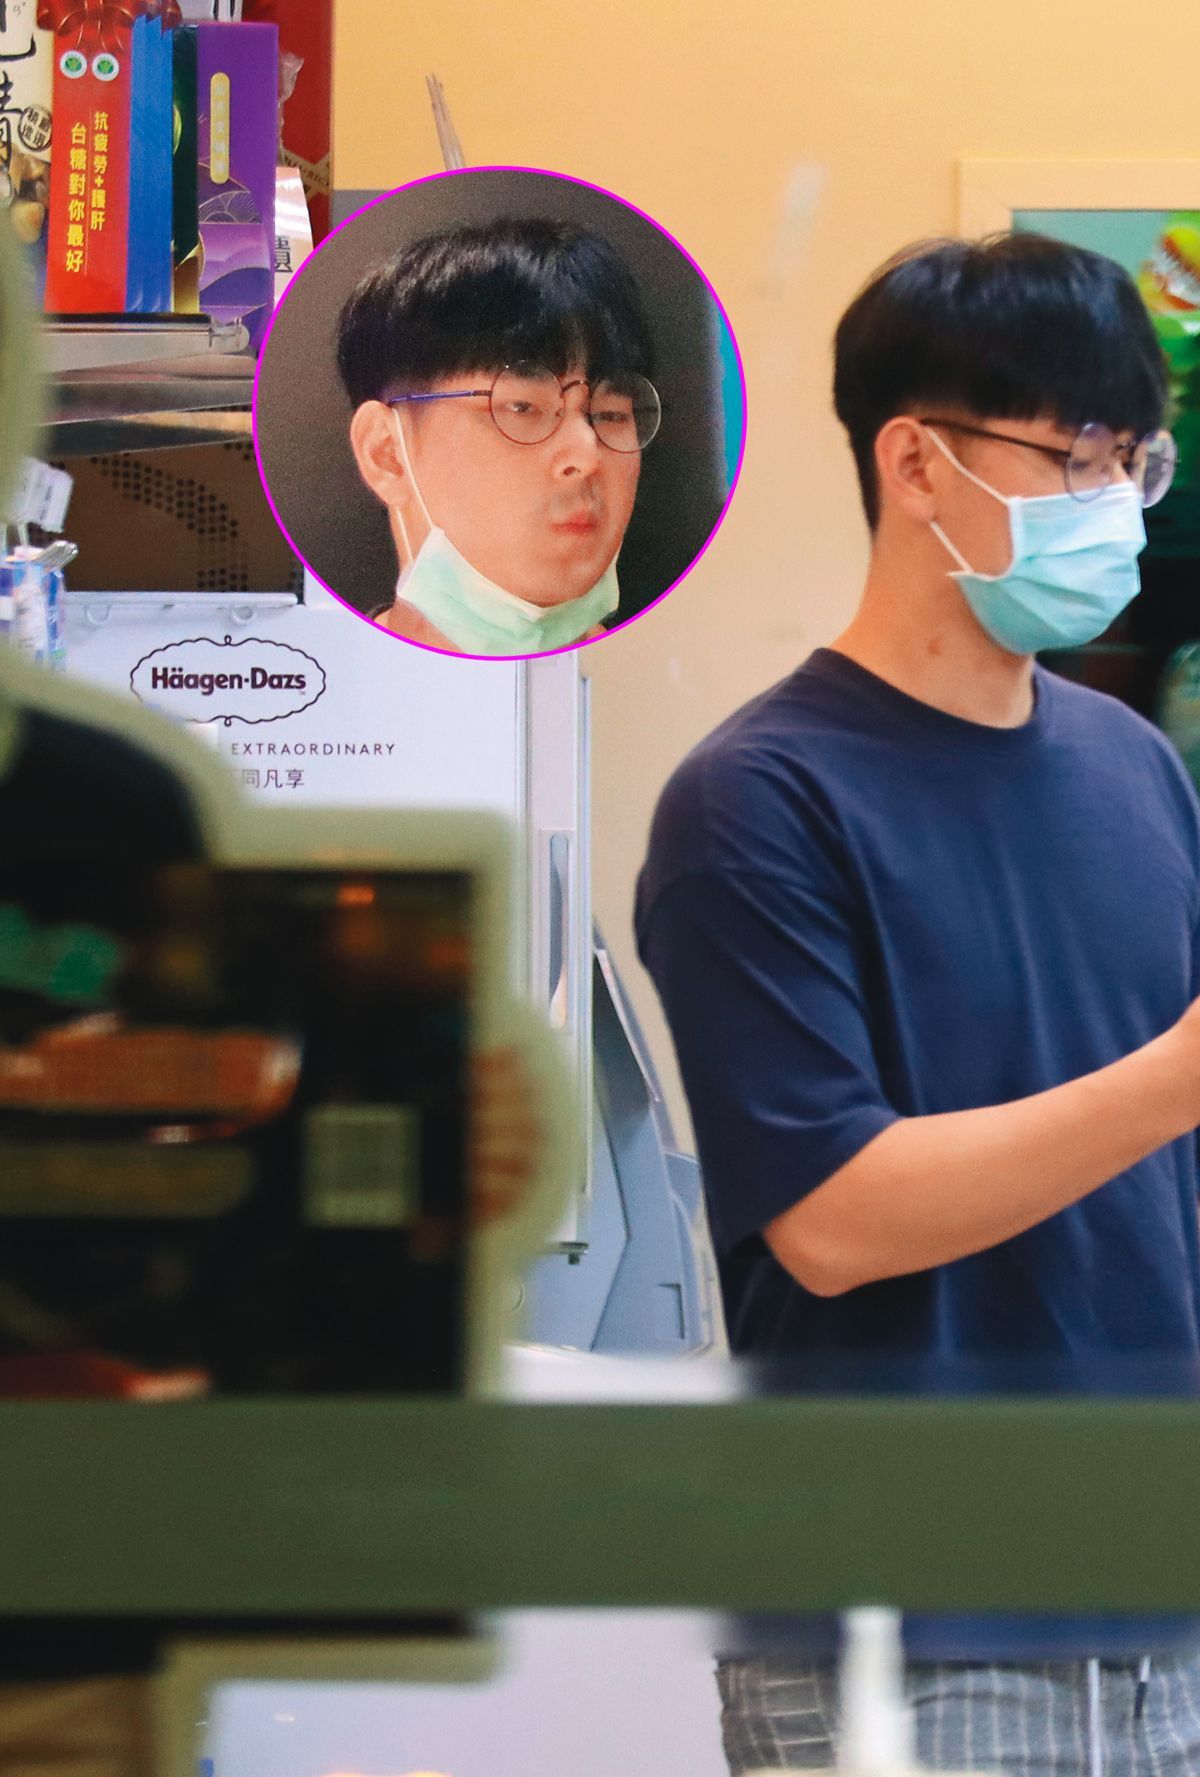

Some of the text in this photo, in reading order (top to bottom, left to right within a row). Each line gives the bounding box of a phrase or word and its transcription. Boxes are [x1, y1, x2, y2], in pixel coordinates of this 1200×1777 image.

[65, 122, 87, 273] 台糖對你最好
[91, 111, 109, 231] 抗疲勞+護肝
[231, 743, 396, 756] EXTRAORDINARY
[232, 768, 305, 789] 同凡享
